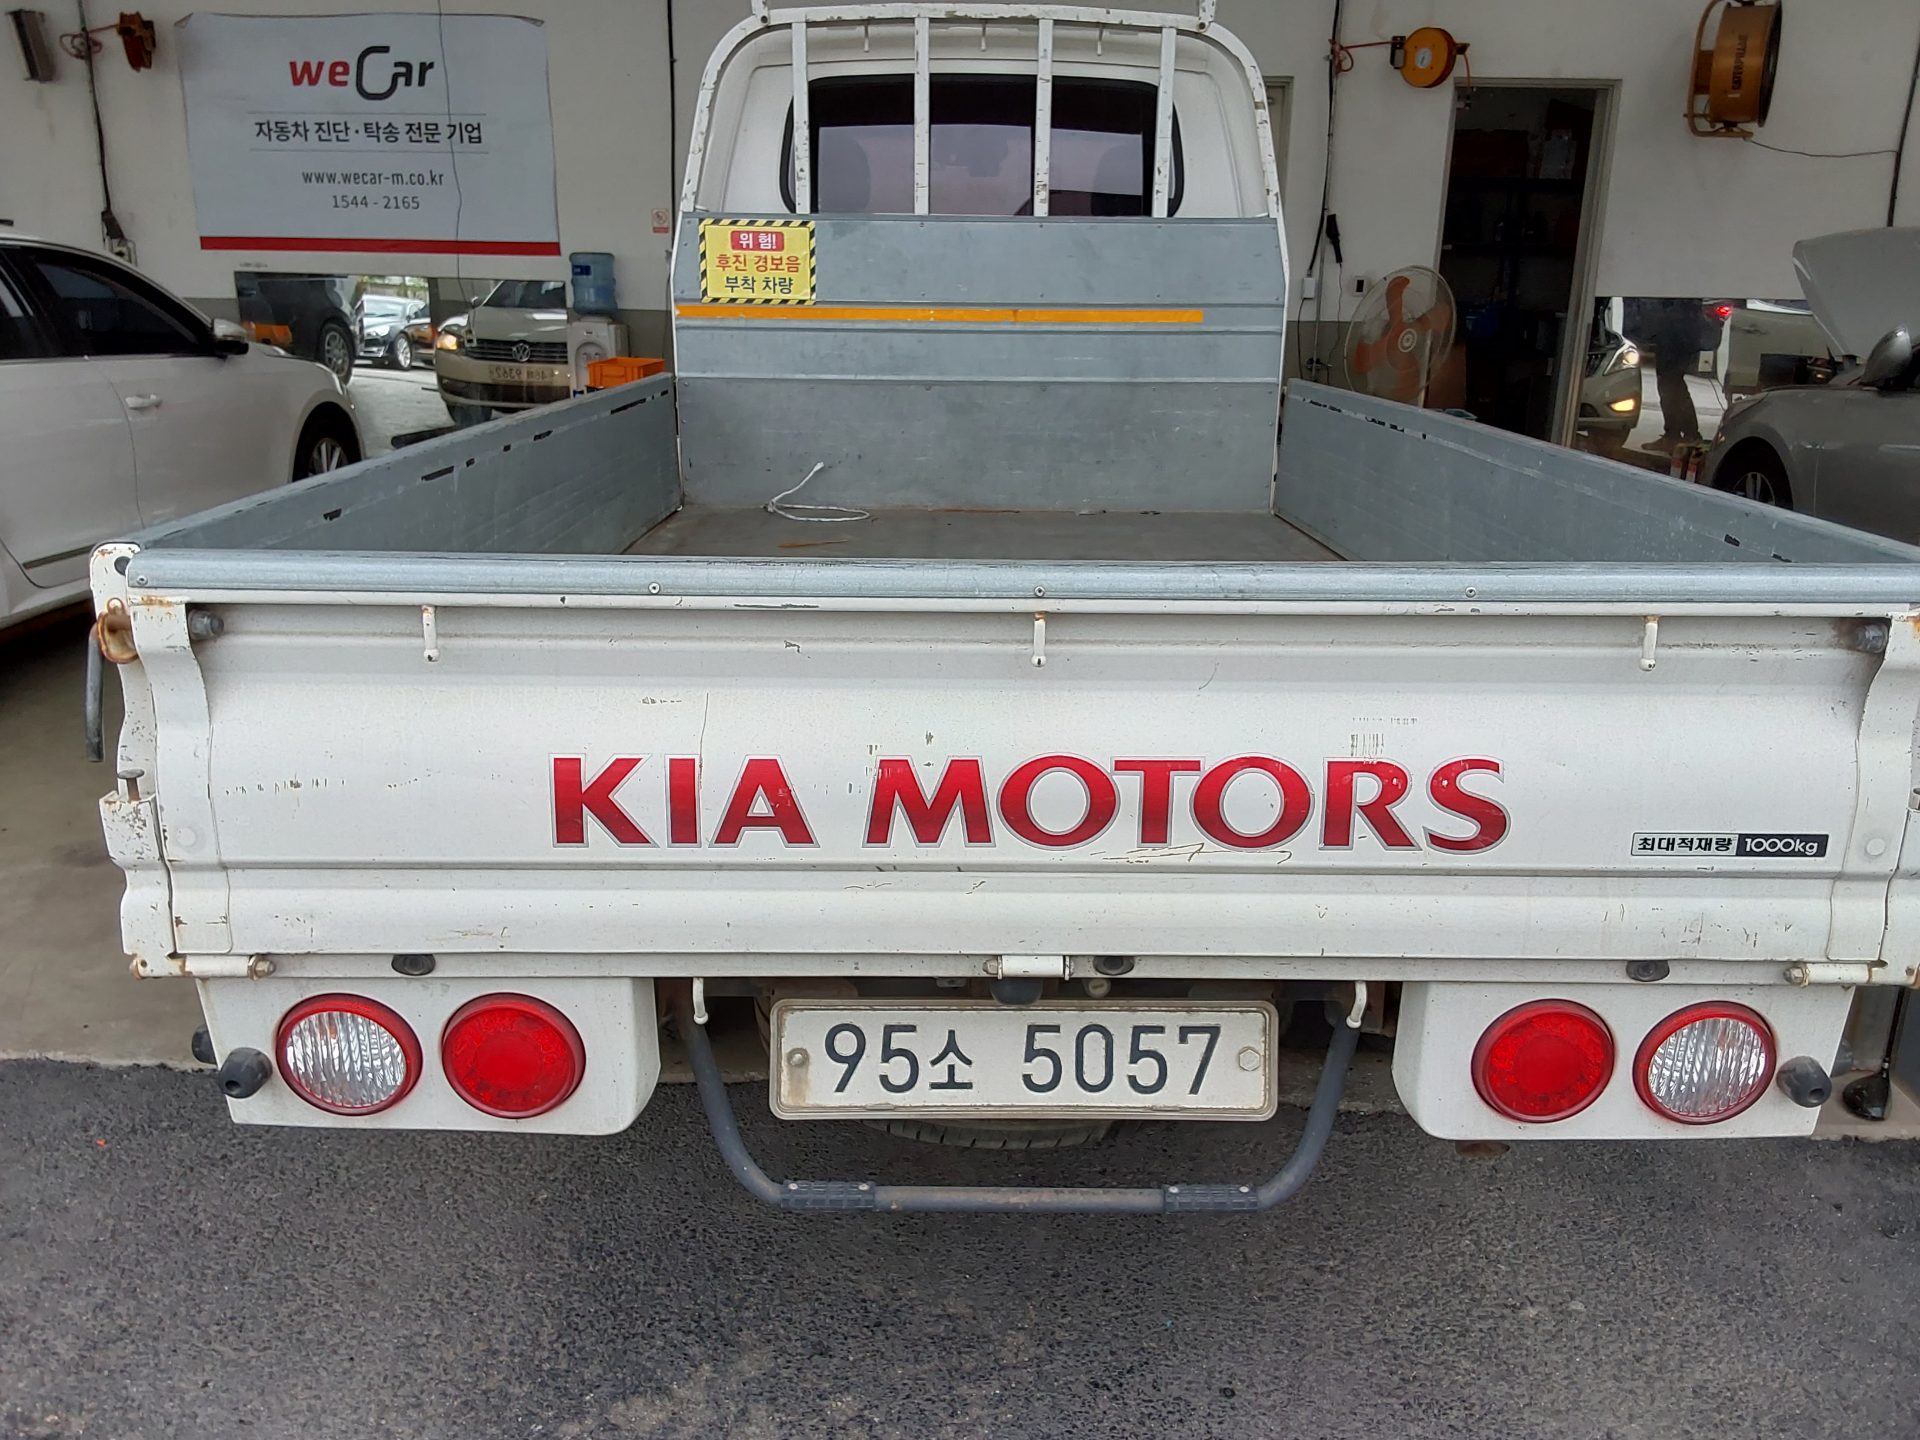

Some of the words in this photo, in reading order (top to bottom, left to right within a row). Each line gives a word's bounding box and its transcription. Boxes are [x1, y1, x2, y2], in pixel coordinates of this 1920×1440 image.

[289, 45, 435, 100] weCar
[255, 120, 310, 142] 자동차
[405, 121, 441, 143] 전문
[447, 121, 482, 144] 기업
[302, 170, 444, 186] www.wecar-m.co.kr
[716, 254, 748, 272] 후진
[754, 255, 801, 273] 경보음
[725, 275, 757, 294] 부착
[762, 276, 794, 295] 차량
[548, 752, 821, 849] KIA
[861, 750, 1512, 856] MOTORS
[1637, 836, 1734, 852] 최대적재량
[1744, 837, 1819, 856] 1000kg
[824, 1022, 974, 1094] 95소
[1021, 1023, 1222, 1096] 5057
